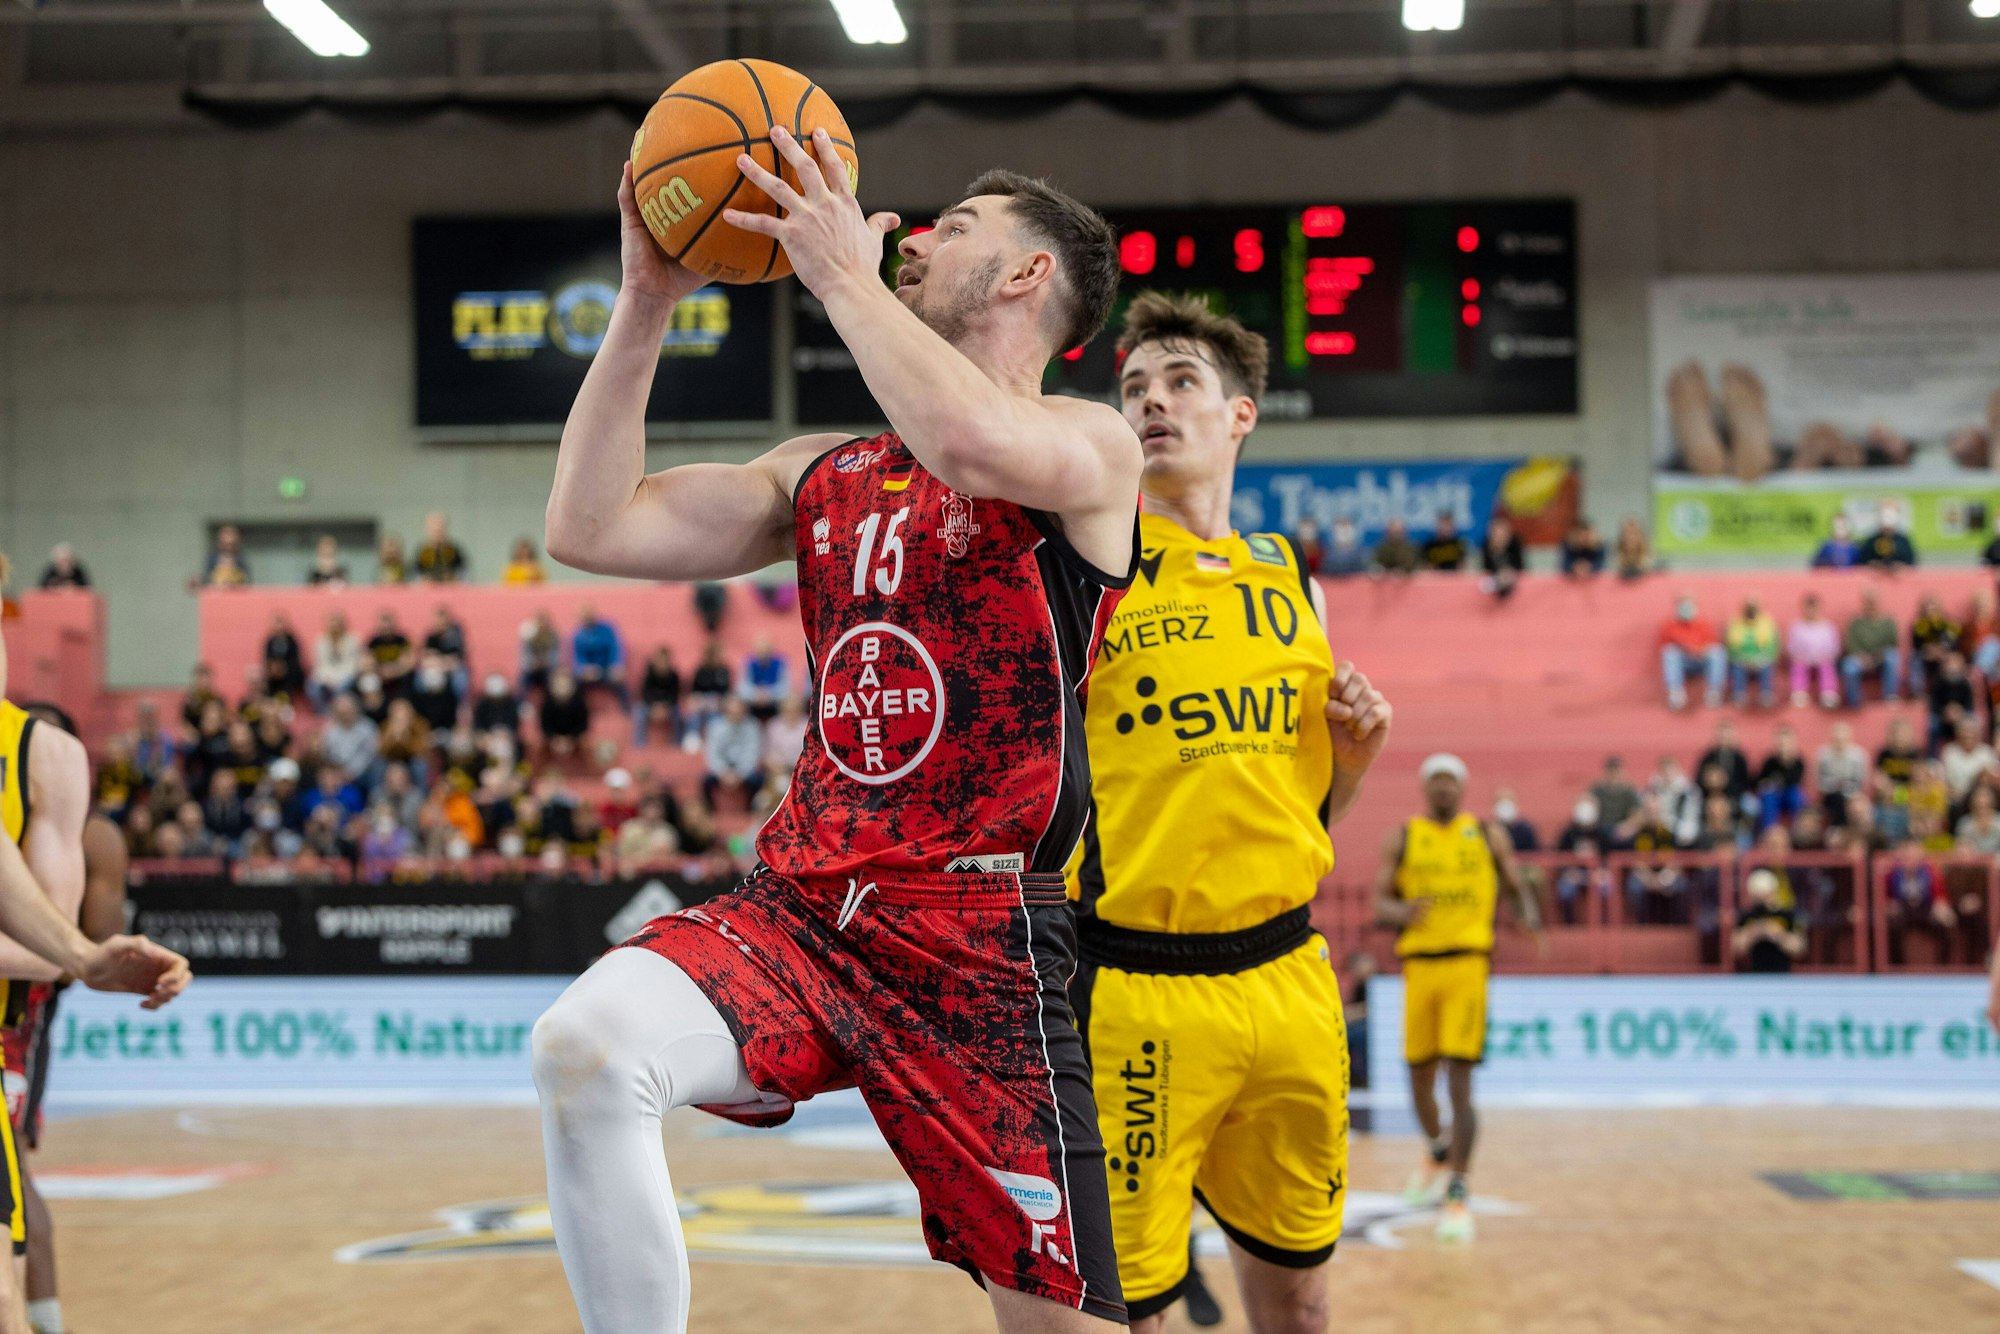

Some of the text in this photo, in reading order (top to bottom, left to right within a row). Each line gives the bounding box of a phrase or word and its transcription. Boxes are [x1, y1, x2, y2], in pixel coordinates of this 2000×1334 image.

[853, 506, 910, 596] 15
[1103, 615, 1215, 663] MERZ
[1233, 582, 1298, 647] 10
[823, 687, 932, 720] BAYER
[856, 636, 887, 772] BAYER
[1178, 740, 1269, 764] Stadtwerke
[991, 857, 1021, 870] SIZE
[60, 1009, 529, 1059] Jetzt 100% Natur
[1573, 1008, 1738, 1059] 100%
[1756, 1010, 1926, 1059] Natur
